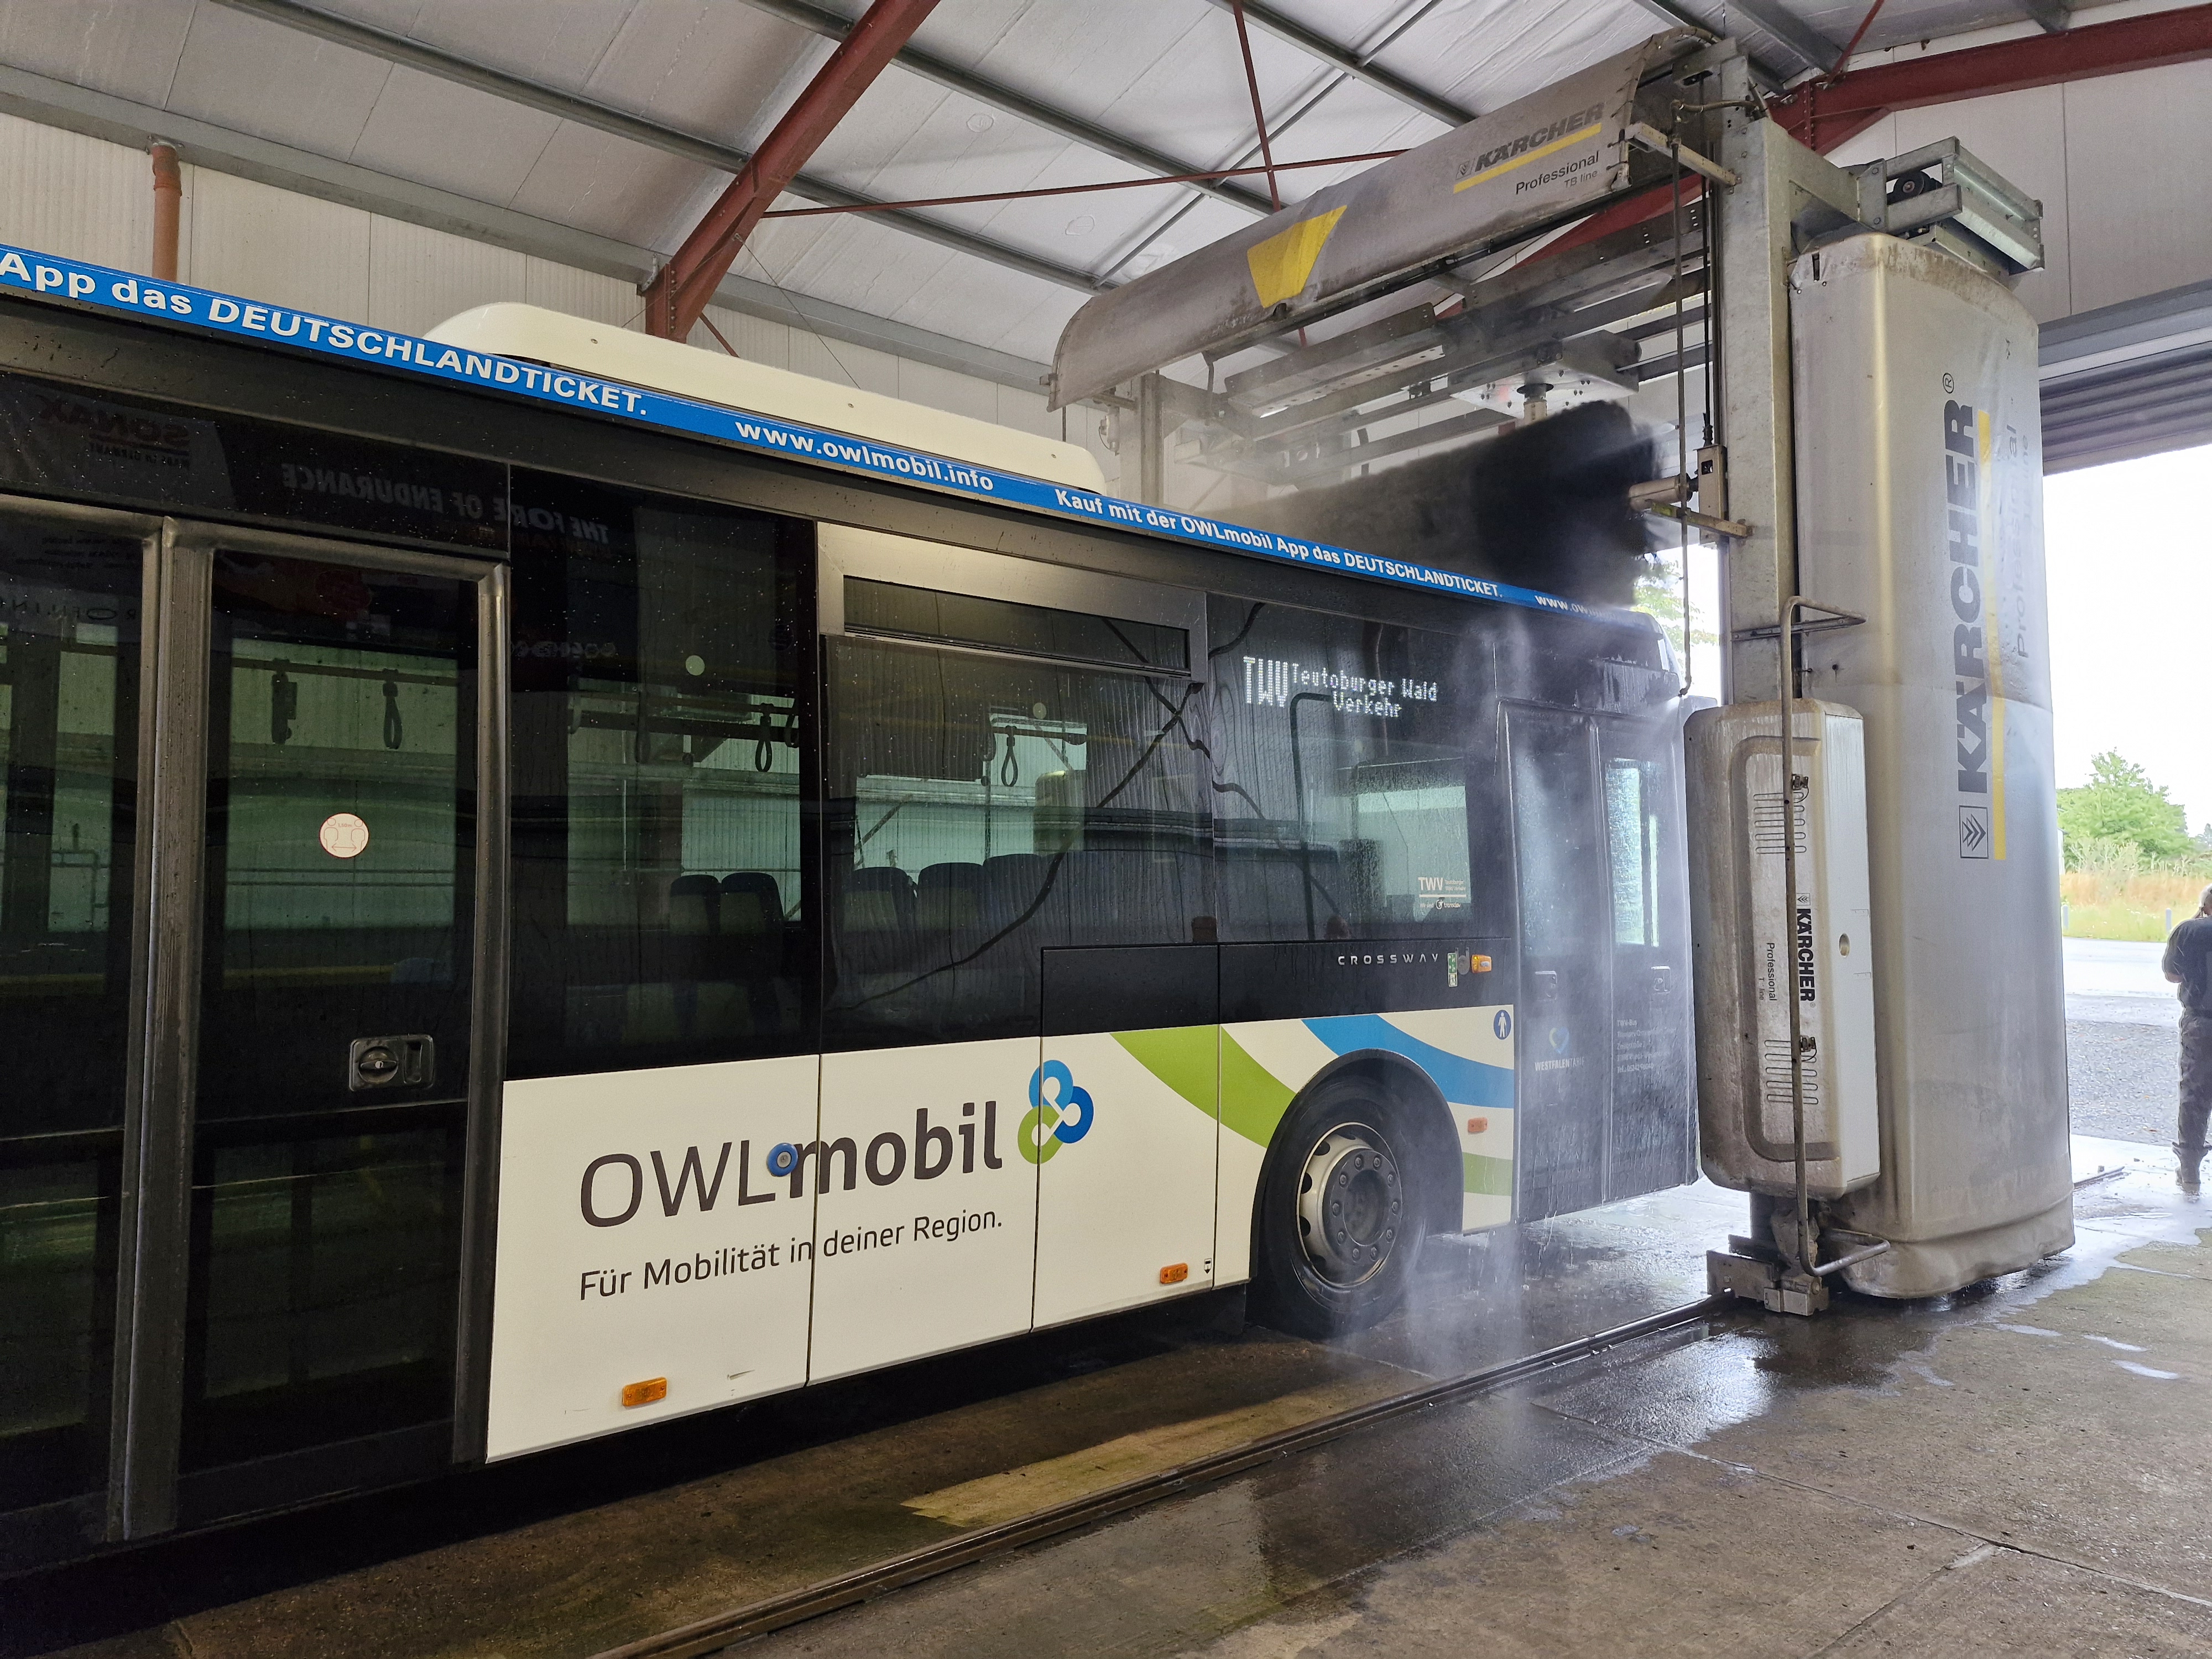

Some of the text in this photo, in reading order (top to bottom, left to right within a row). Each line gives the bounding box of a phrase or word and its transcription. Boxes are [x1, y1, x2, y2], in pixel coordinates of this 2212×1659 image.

[1475, 103, 1605, 172] KÄRCHER
[1516, 150, 1600, 195] Professional
[1564, 169, 1598, 188] TB line
[0, 252, 648, 416] App das DEUTSCHLANDTICKET.
[735, 421, 994, 491] www.owlmobil.info
[1055, 489, 1504, 598] Kauf mit der OWLmobil App das DEUTSCHLANDTICKET.
[1243, 655, 1438, 708] TWV Teutoburger Wald
[1333, 691, 1402, 718] Verkehr
[1418, 877, 1443, 891] TWV
[1338, 952, 1438, 966] CROSSWAY
[1766, 942, 1777, 1001] Professional
[1535, 1057, 1585, 1071] WESTFALENTARIF
[580, 1208, 1003, 1301] Für Mobilität in deiner Region.
